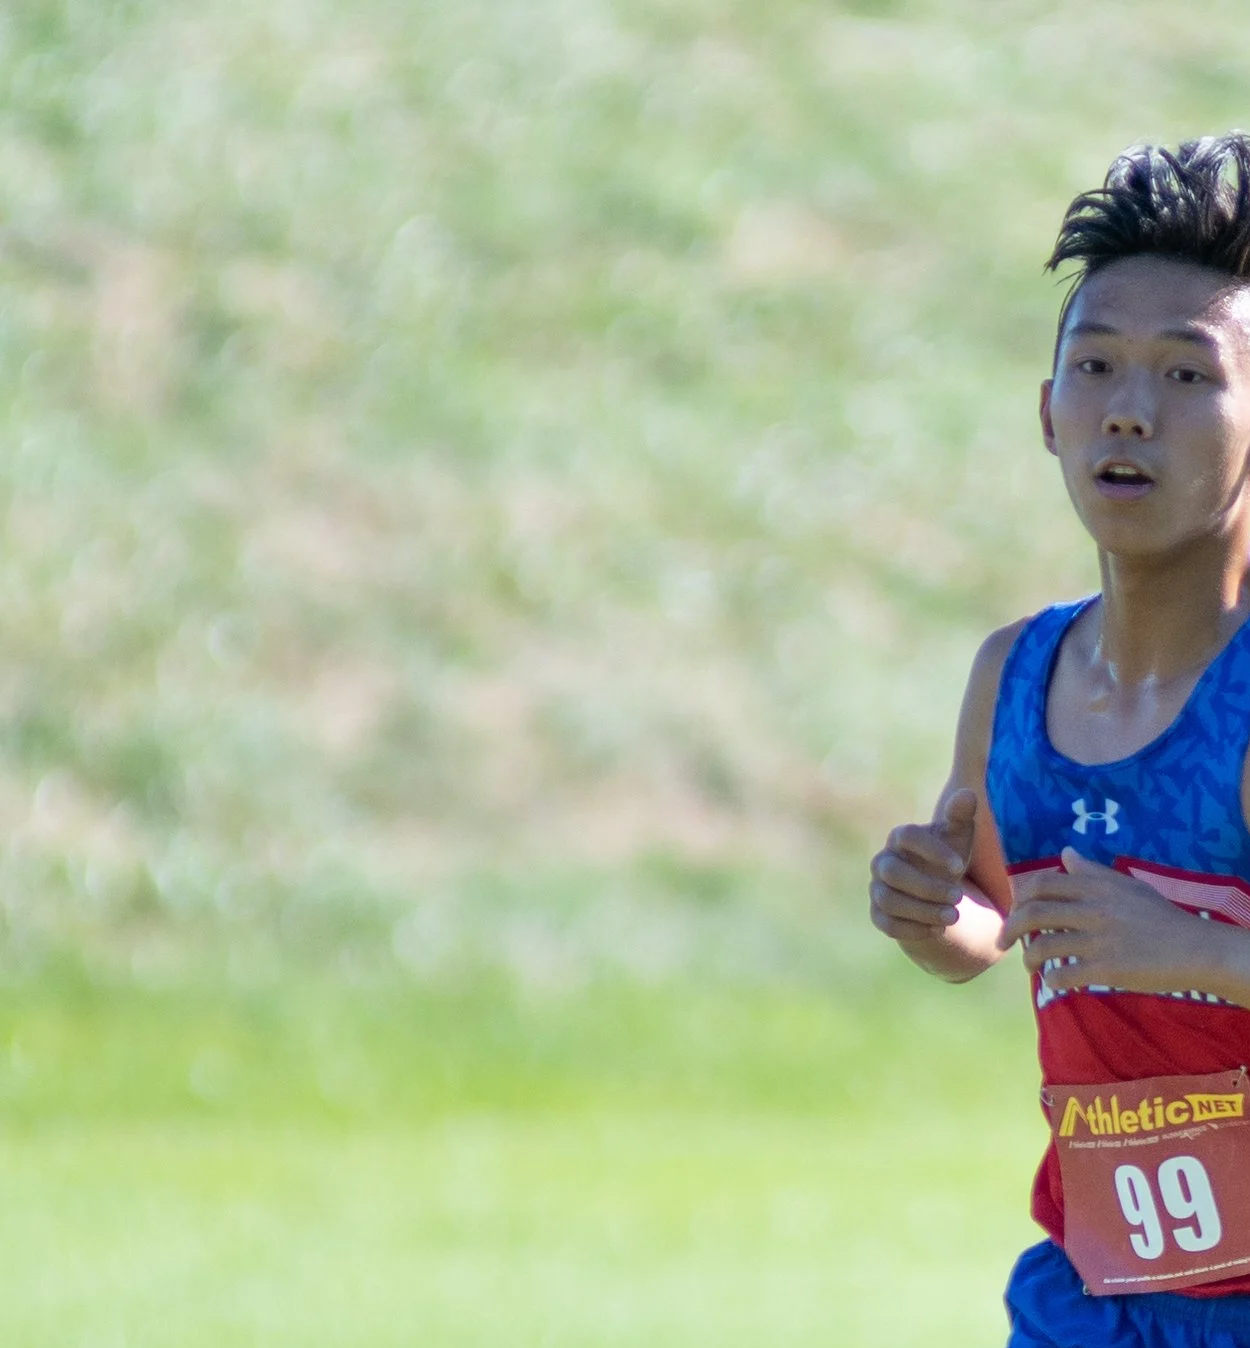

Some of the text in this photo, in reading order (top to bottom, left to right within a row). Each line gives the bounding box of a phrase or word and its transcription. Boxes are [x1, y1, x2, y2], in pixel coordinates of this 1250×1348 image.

[1059, 1094, 1189, 1137] Athletic
[1198, 1100, 1236, 1115] NET
[1114, 1155, 1222, 1260] 99
